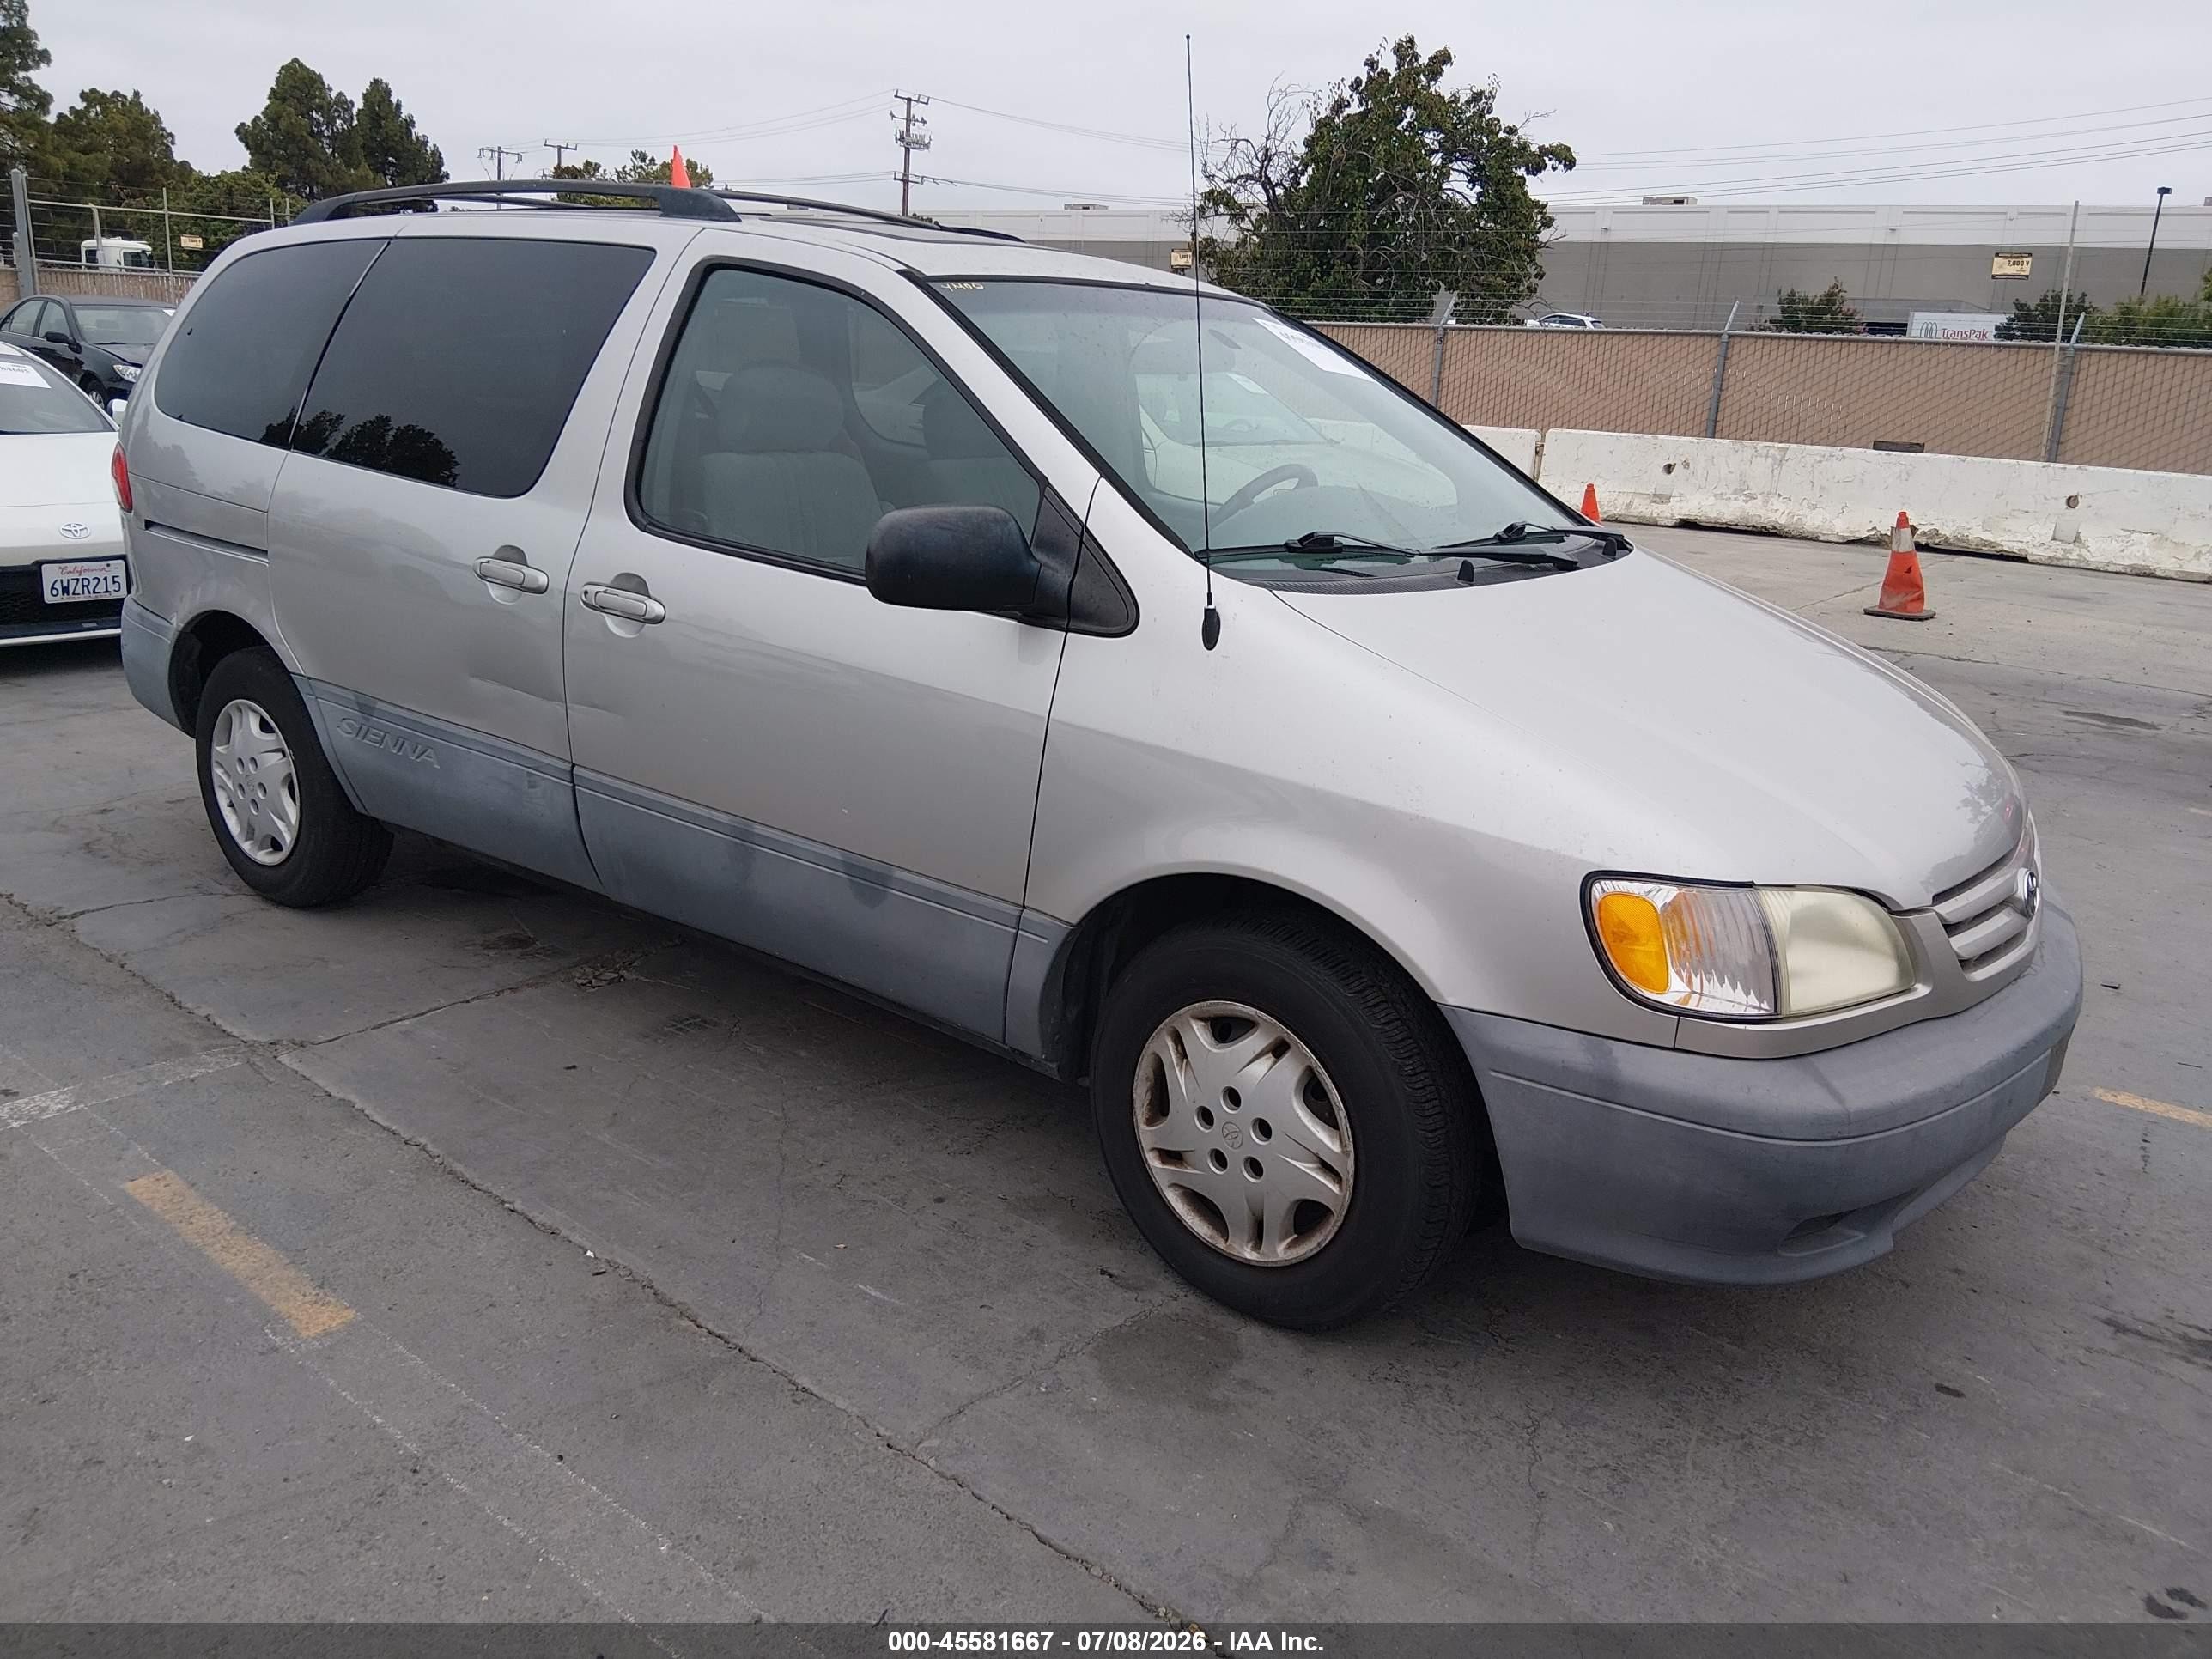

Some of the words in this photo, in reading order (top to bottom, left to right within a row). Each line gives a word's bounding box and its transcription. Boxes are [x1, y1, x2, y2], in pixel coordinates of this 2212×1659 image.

[1942, 328, 1988, 339] TransPak
[50, 575, 121, 598] 6WZR215
[336, 717, 441, 769] SIENNA
